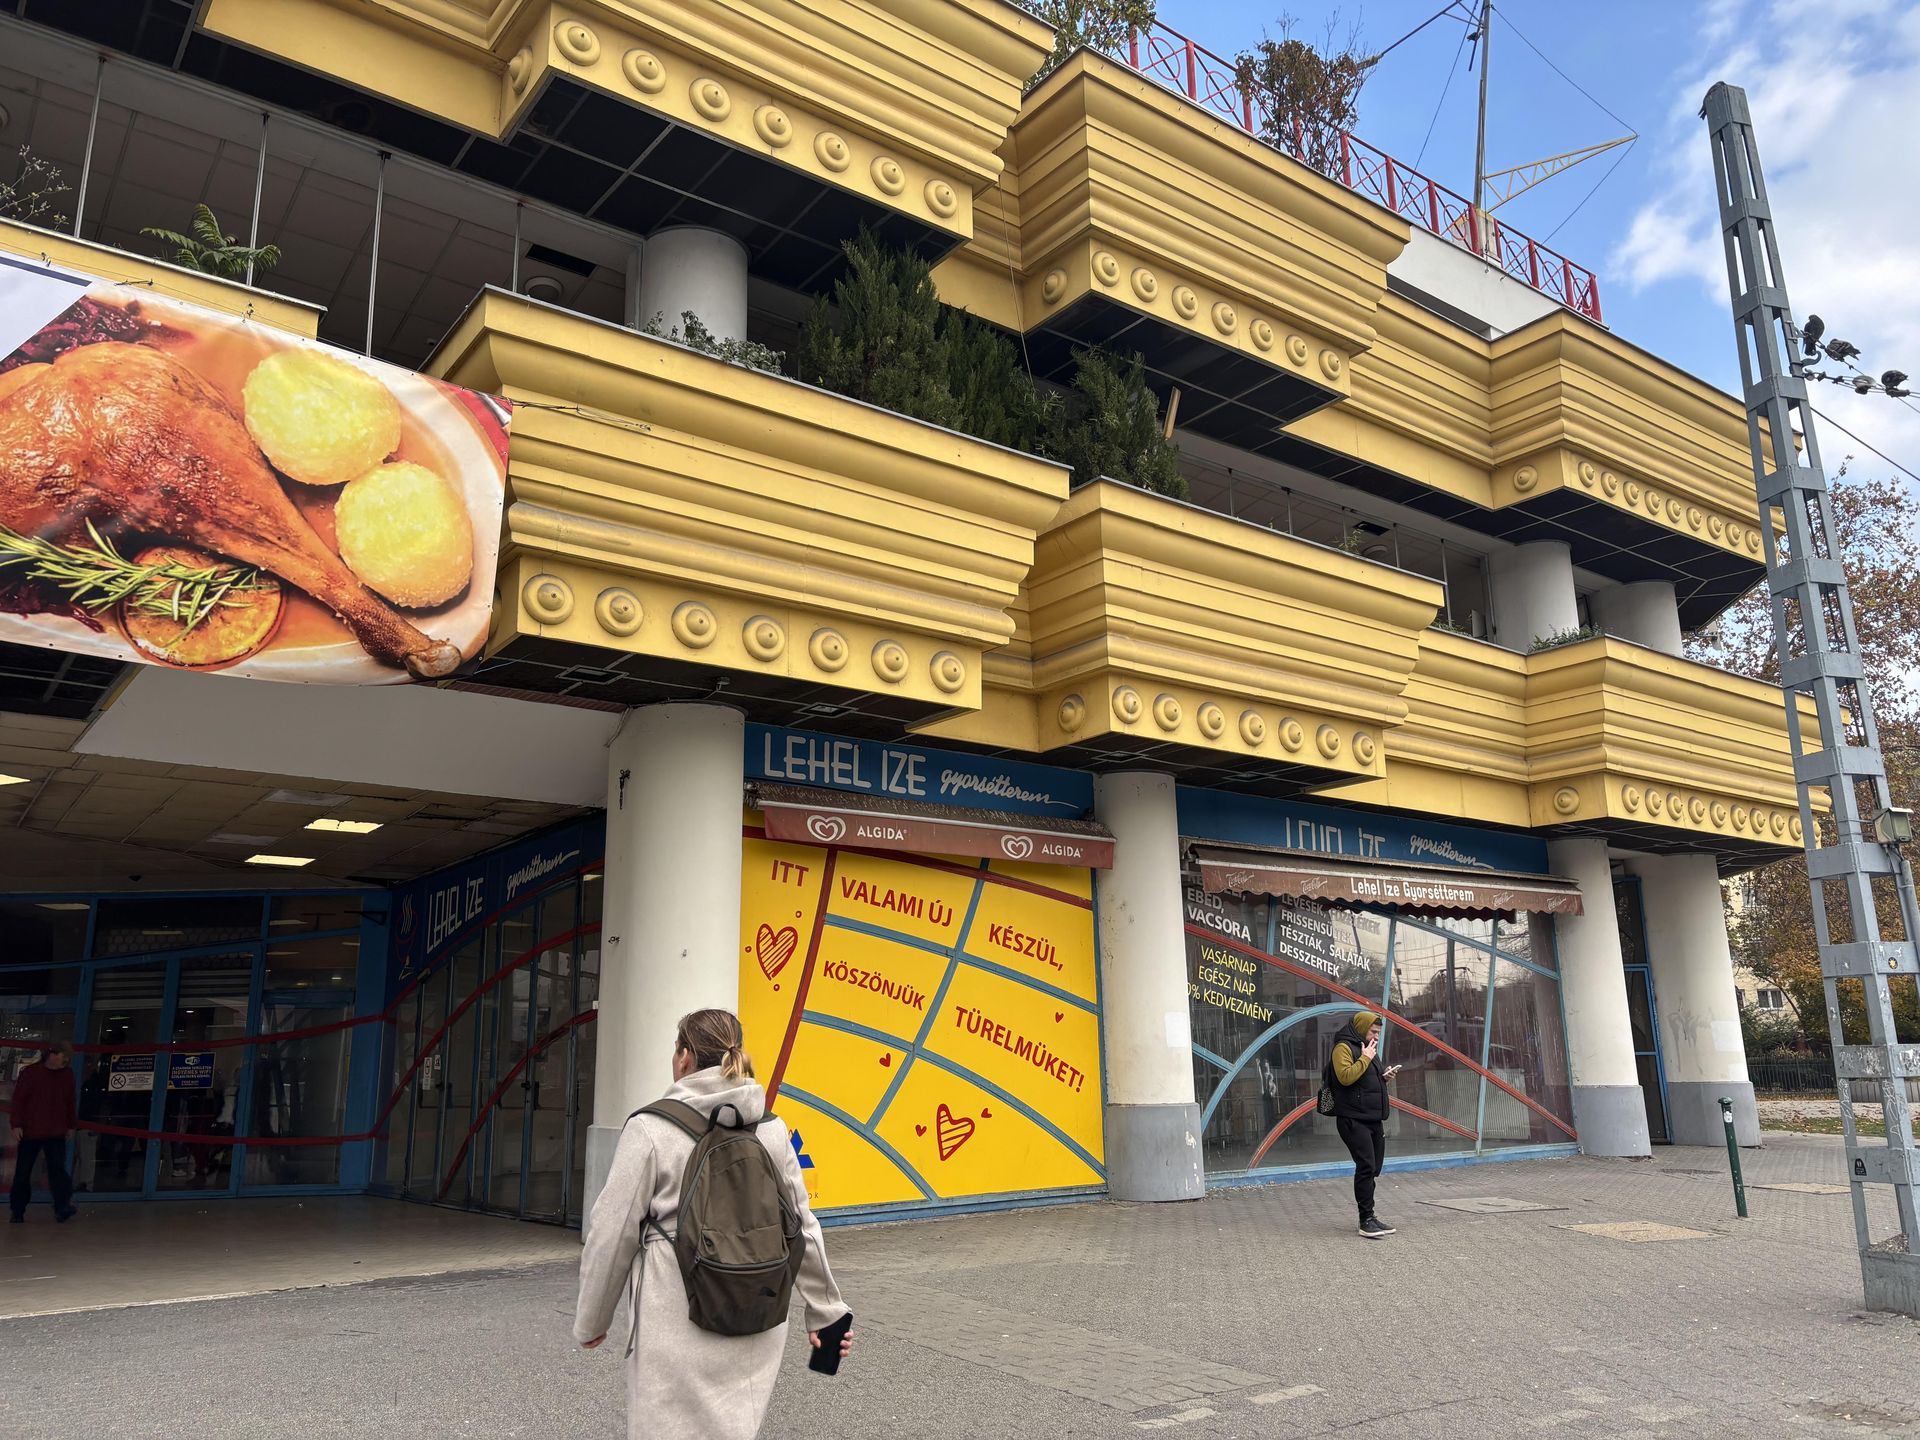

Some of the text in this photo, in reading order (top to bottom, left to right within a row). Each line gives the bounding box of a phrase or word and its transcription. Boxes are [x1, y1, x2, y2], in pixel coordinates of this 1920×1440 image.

[764, 732, 872, 788] LEHEL
[940, 769, 1080, 809] gyorsétterem
[1410, 834, 1495, 870] gyorsétterem
[771, 859, 809, 887] ITT
[1350, 877, 1381, 896] Lehel
[1402, 881, 1475, 902] Gyorsétterem
[427, 885, 462, 954] LEHEL
[840, 876, 953, 928] VALAMI ÚJ
[1187, 904, 1252, 942] VACSORA
[988, 923, 1064, 971] KÉSZÜL,
[1201, 945, 1258, 977] VASÁRNAP
[1279, 941, 1340, 978] DESSZERTEK
[1280, 924, 1371, 972] TÉSZTÁK, SALÁTÁK
[822, 960, 926, 1011] KÖSZÖNJÜK
[1198, 965, 1257, 998] EGÉSZ NAP
[1203, 987, 1274, 1024] KEDVEZMÉNY
[955, 1005, 1086, 1094] TÜRELMÜKET!
